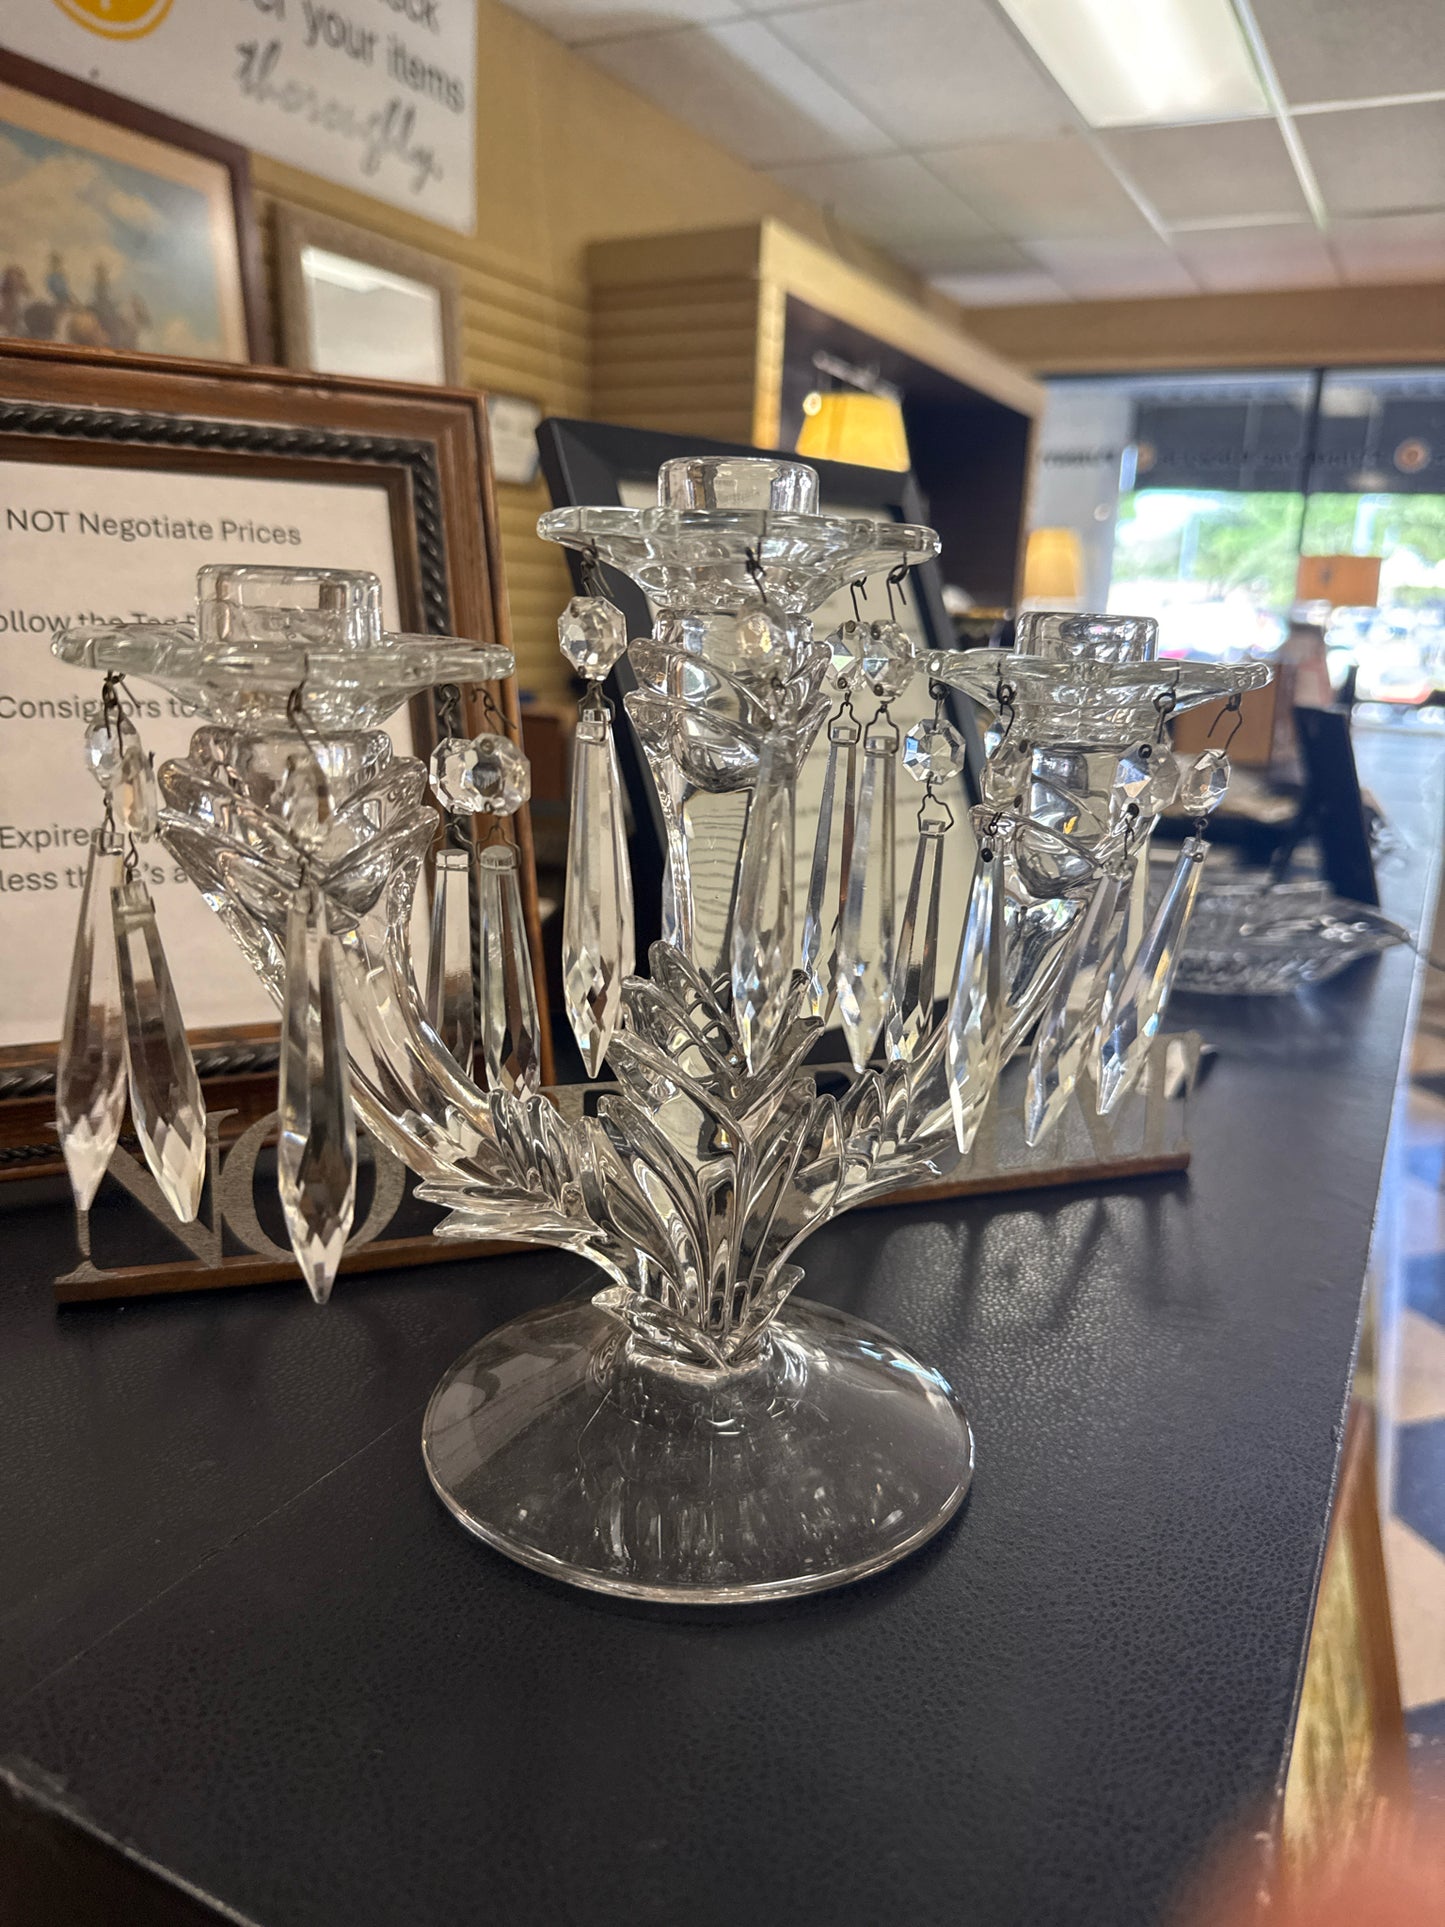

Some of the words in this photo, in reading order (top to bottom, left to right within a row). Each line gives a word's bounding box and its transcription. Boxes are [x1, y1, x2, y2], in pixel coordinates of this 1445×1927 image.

[303, 0, 378, 66] your
[387, 34, 466, 114] items
[6, 508, 69, 532] NOT
[79, 511, 213, 542] Negotiate
[221, 519, 302, 546] Prices
[0, 694, 161, 723] Consigors
[0, 824, 97, 853] Expire
